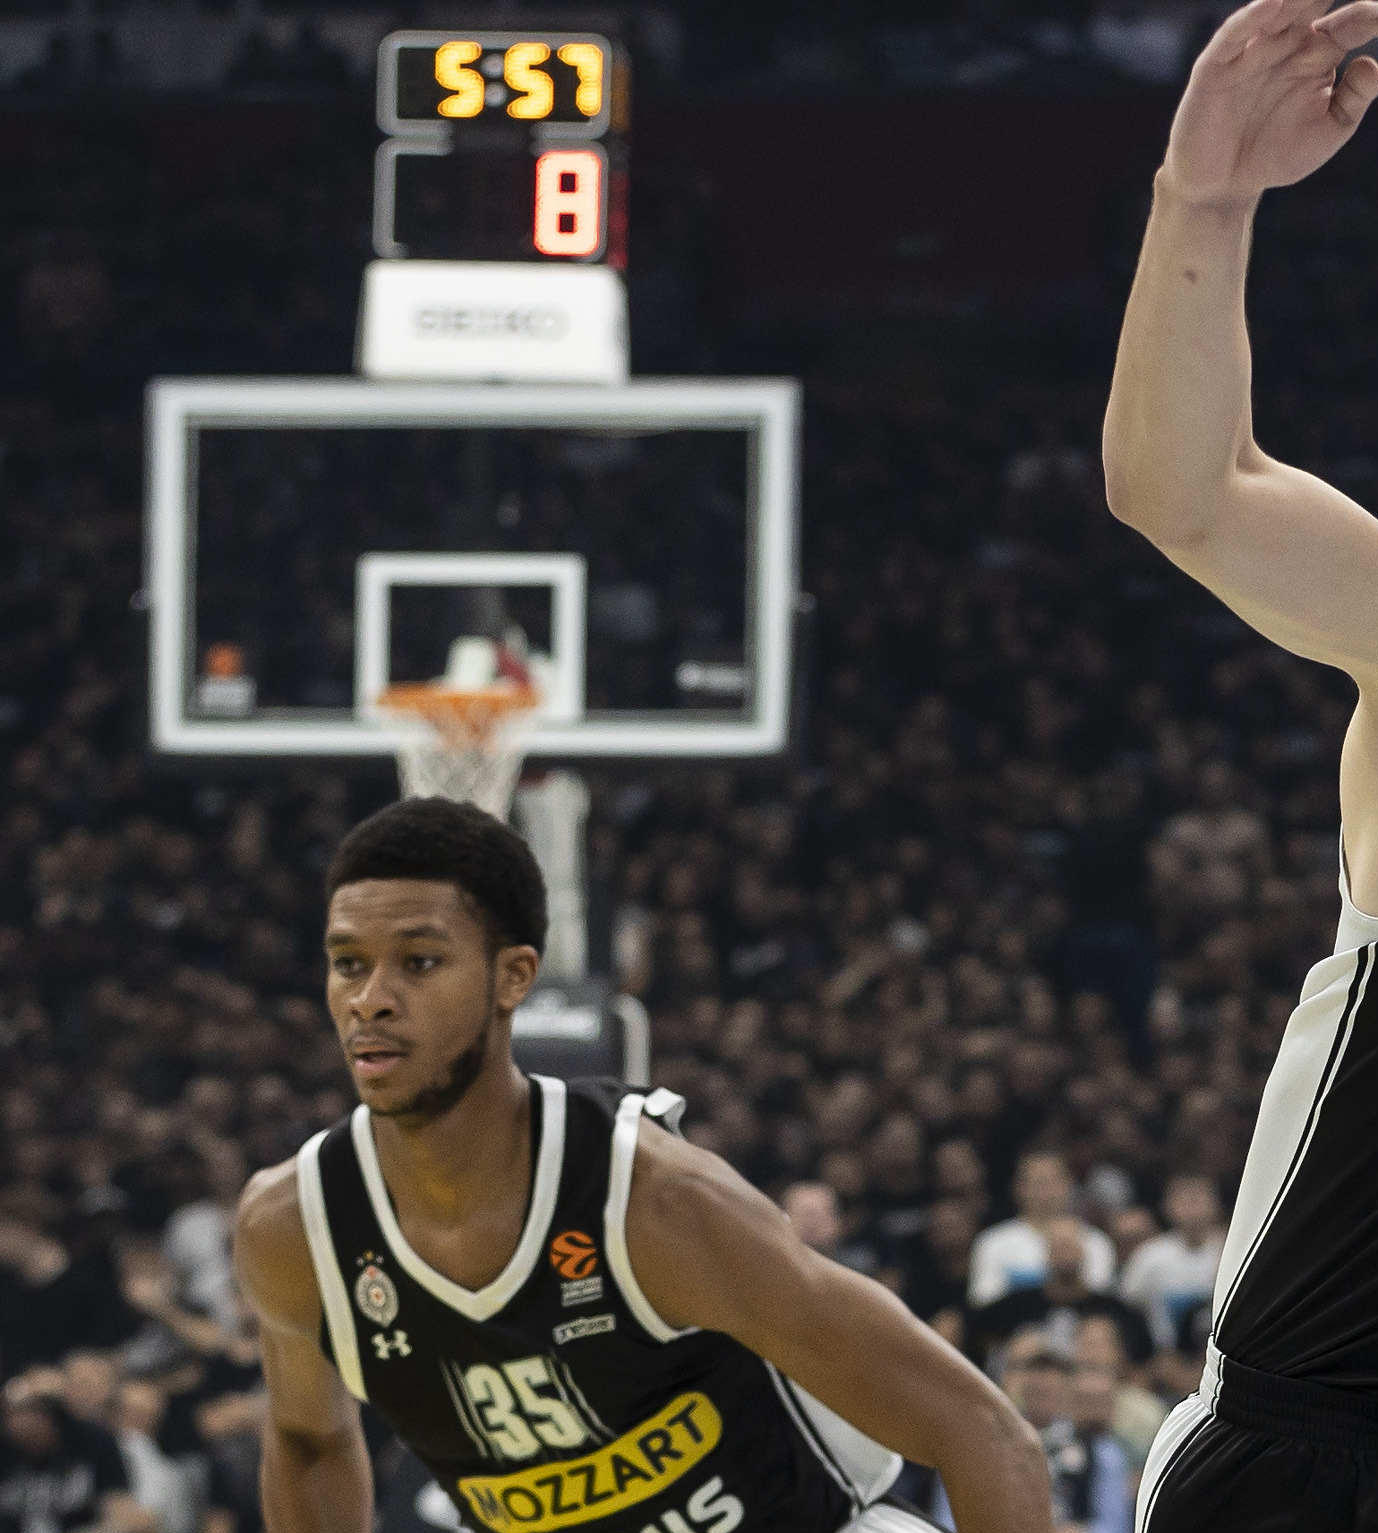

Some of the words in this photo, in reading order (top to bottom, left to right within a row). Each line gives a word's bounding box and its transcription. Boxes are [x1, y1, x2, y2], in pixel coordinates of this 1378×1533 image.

[435, 41, 603, 118] 5:57
[534, 150, 601, 257] 8
[463, 1356, 588, 1458] 35
[470, 1401, 706, 1527] MOZZART
